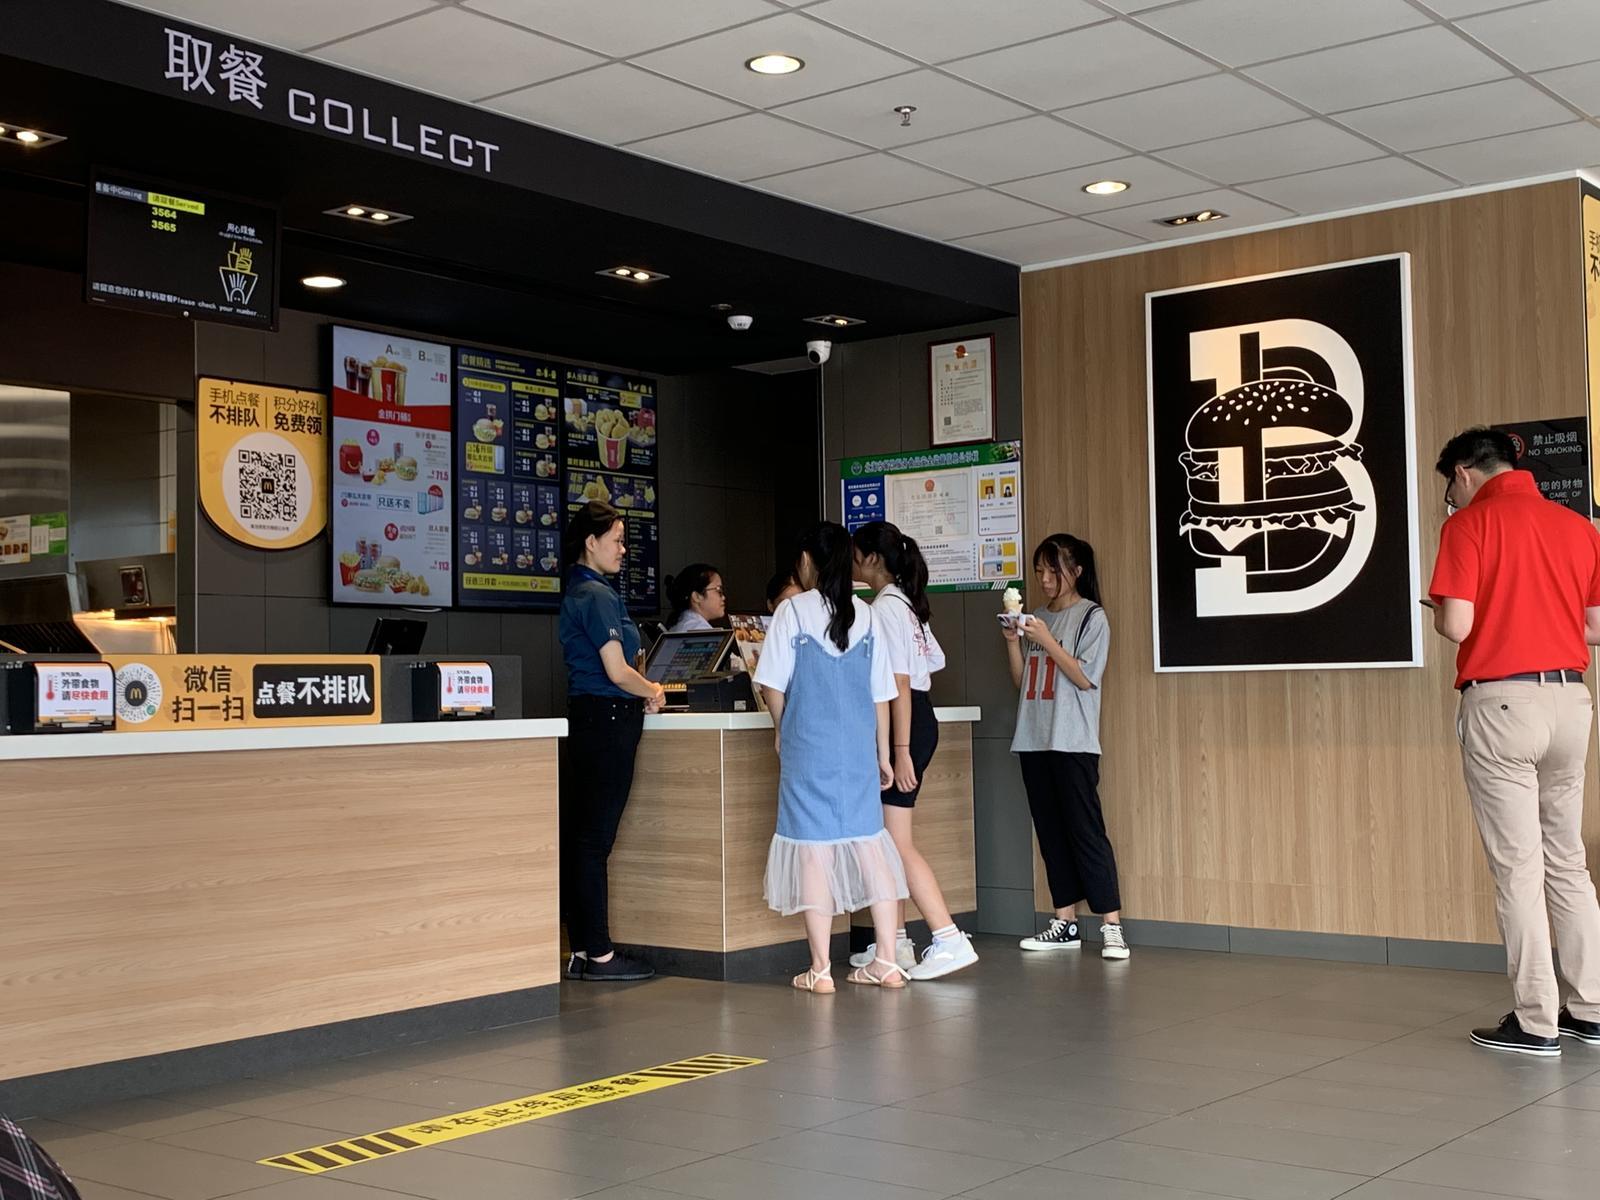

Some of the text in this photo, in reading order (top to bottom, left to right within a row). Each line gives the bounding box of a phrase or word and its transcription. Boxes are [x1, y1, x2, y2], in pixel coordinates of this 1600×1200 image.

[163, 27, 500, 173] 取餐 COLLECT
[151, 206, 177, 219] 3564
[151, 219, 177, 233] 3565
[209, 387, 260, 407] 手机点餐
[274, 396, 322, 416] 积分好礼
[209, 404, 260, 428] 不排队
[274, 412, 322, 435] 免费领
[1533, 431, 1577, 446] 禁止吸烟
[1528, 445, 1582, 457] NO SMOKING
[1536, 479, 1583, 492] 您的财物
[62, 679, 99, 689] 外带食物
[184, 665, 232, 693] 微信
[1026, 656, 1055, 700] 11
[62, 690, 108, 701] 请尽快食用
[256, 675, 371, 705] 点餐不排队
[172, 695, 245, 723] 扫一扫
